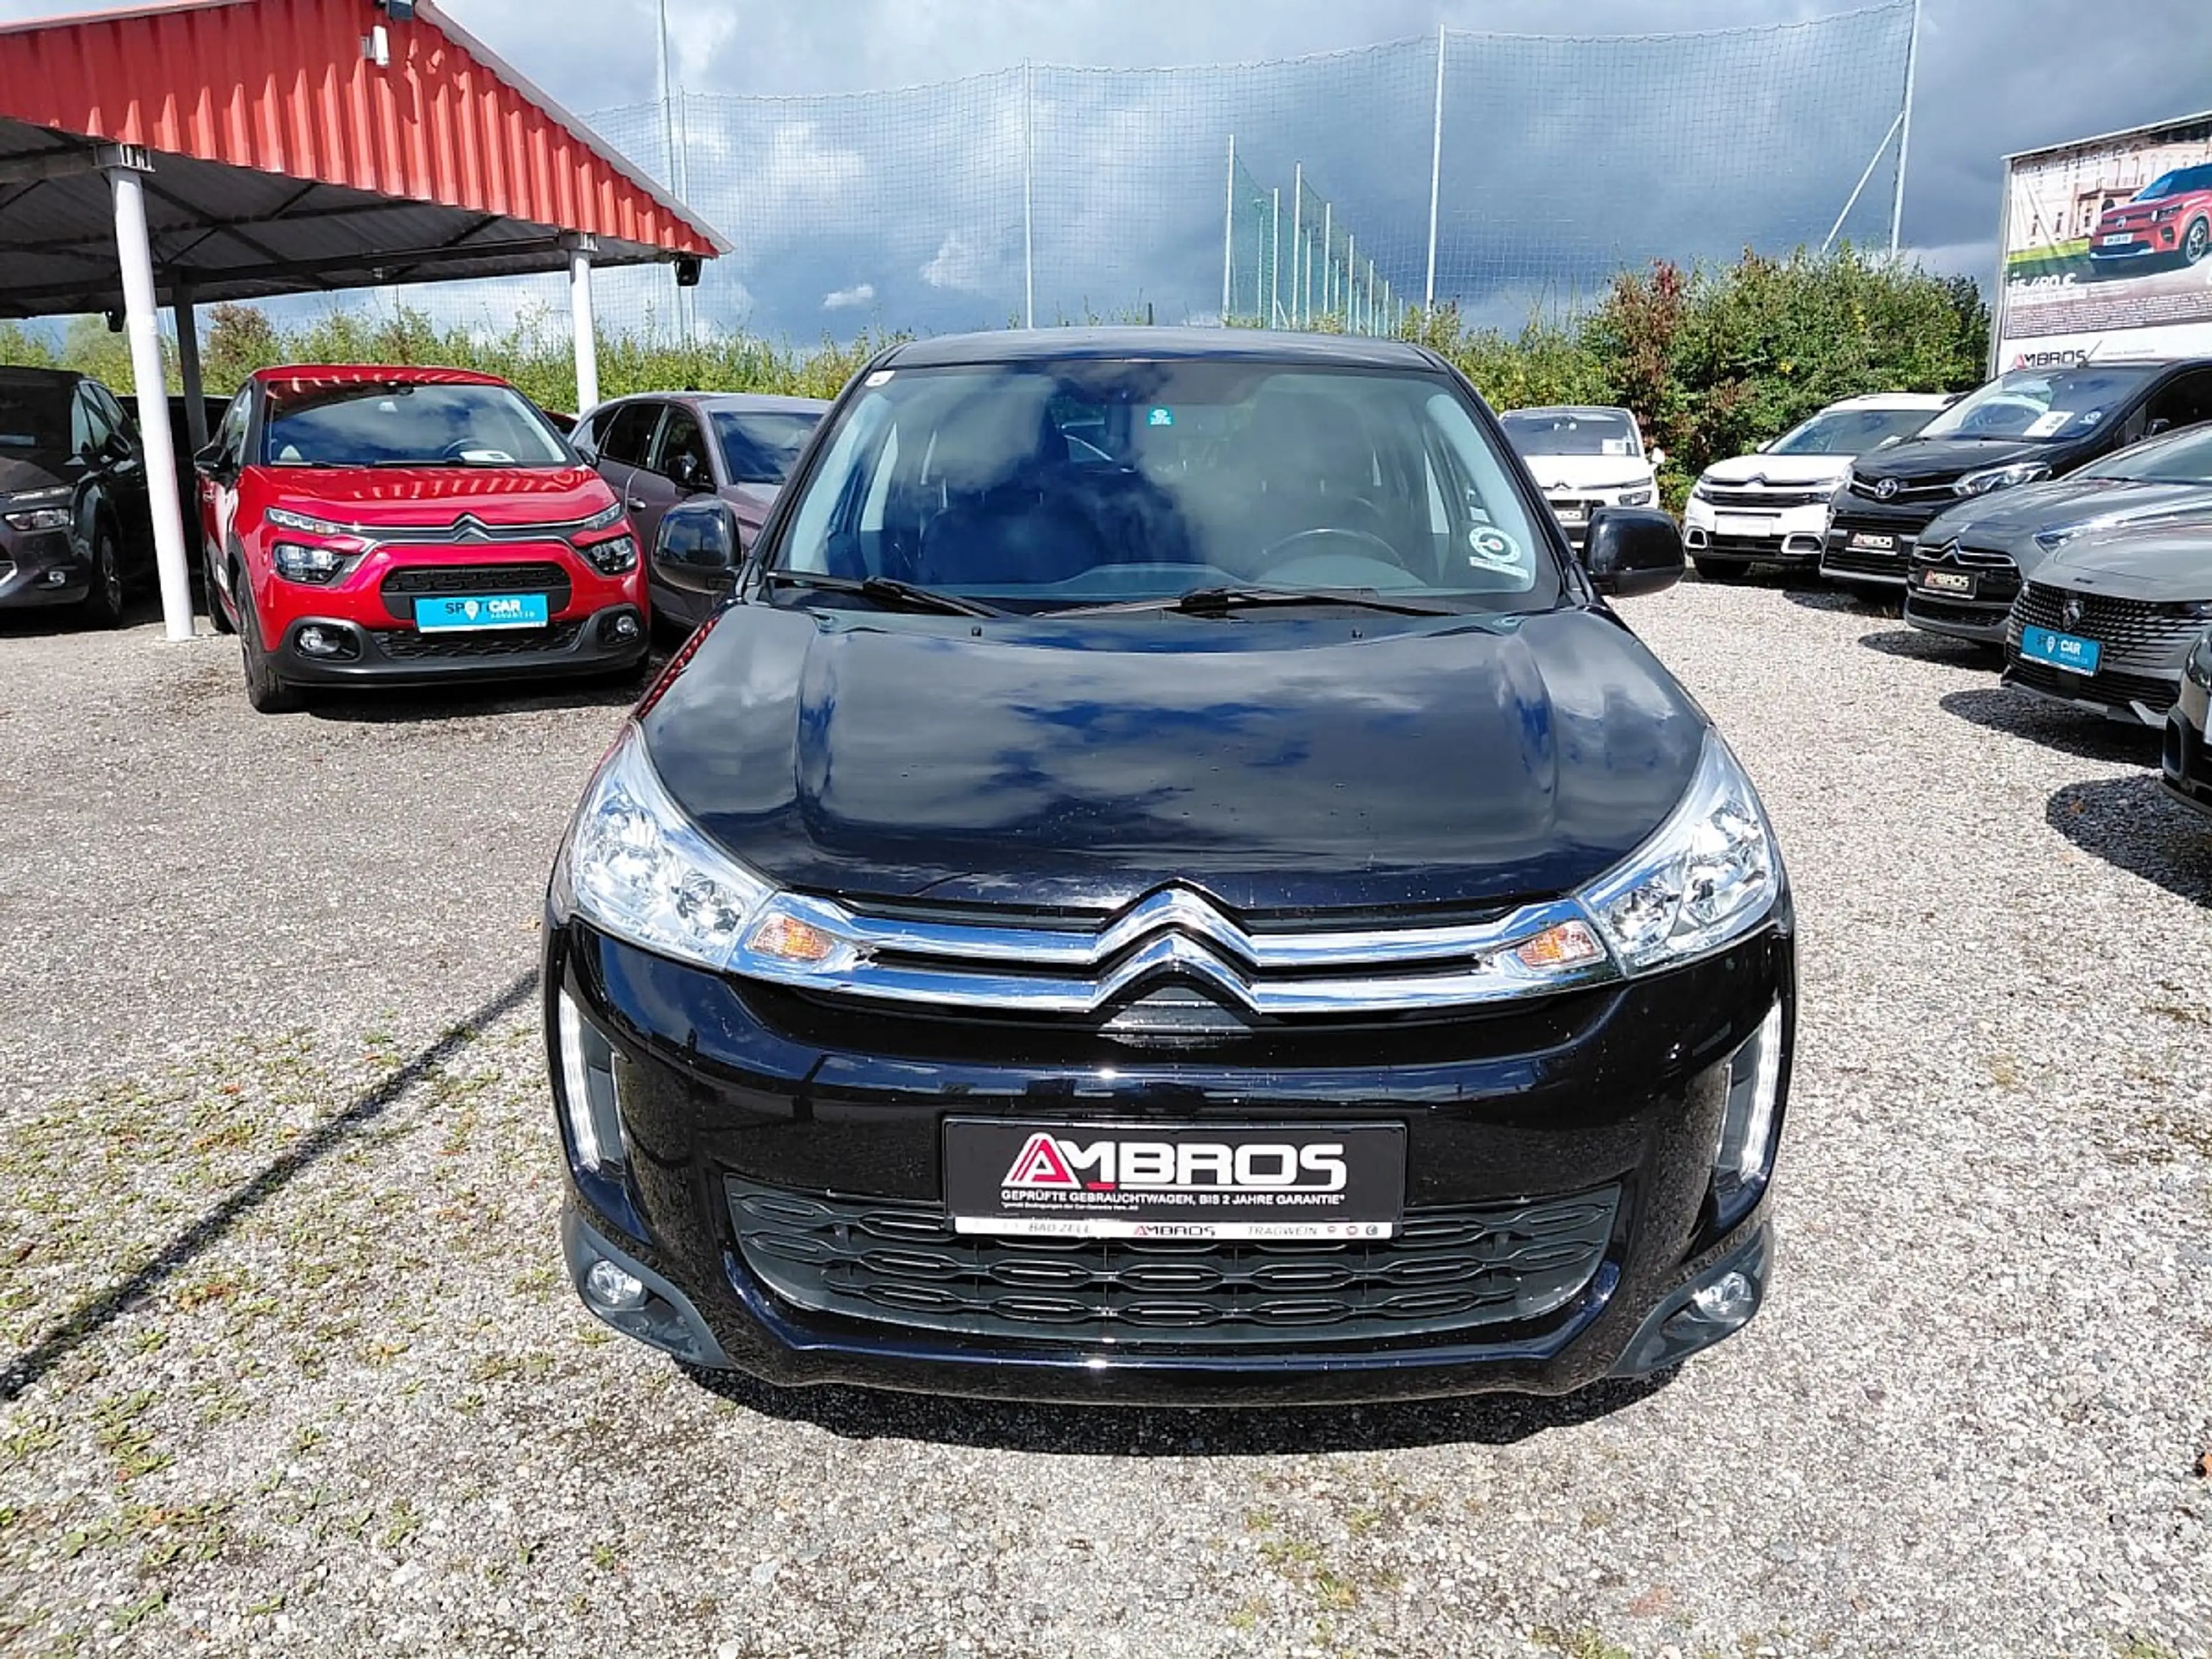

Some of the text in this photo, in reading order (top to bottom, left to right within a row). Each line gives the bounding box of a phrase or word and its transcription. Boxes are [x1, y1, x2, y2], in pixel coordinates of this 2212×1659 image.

[1001, 1132, 1347, 1191] AMBROS
[1001, 1189, 1066, 1201] GEPRÜFTE
[1070, 1192, 1196, 1206] GEBRAUCHTWAGEN,
[1199, 1194, 1219, 1205] BIS
[1222, 1194, 1230, 1205] 2
[1232, 1194, 1273, 1205] JAHRE
[1133, 1225, 1215, 1237] AMBROS
